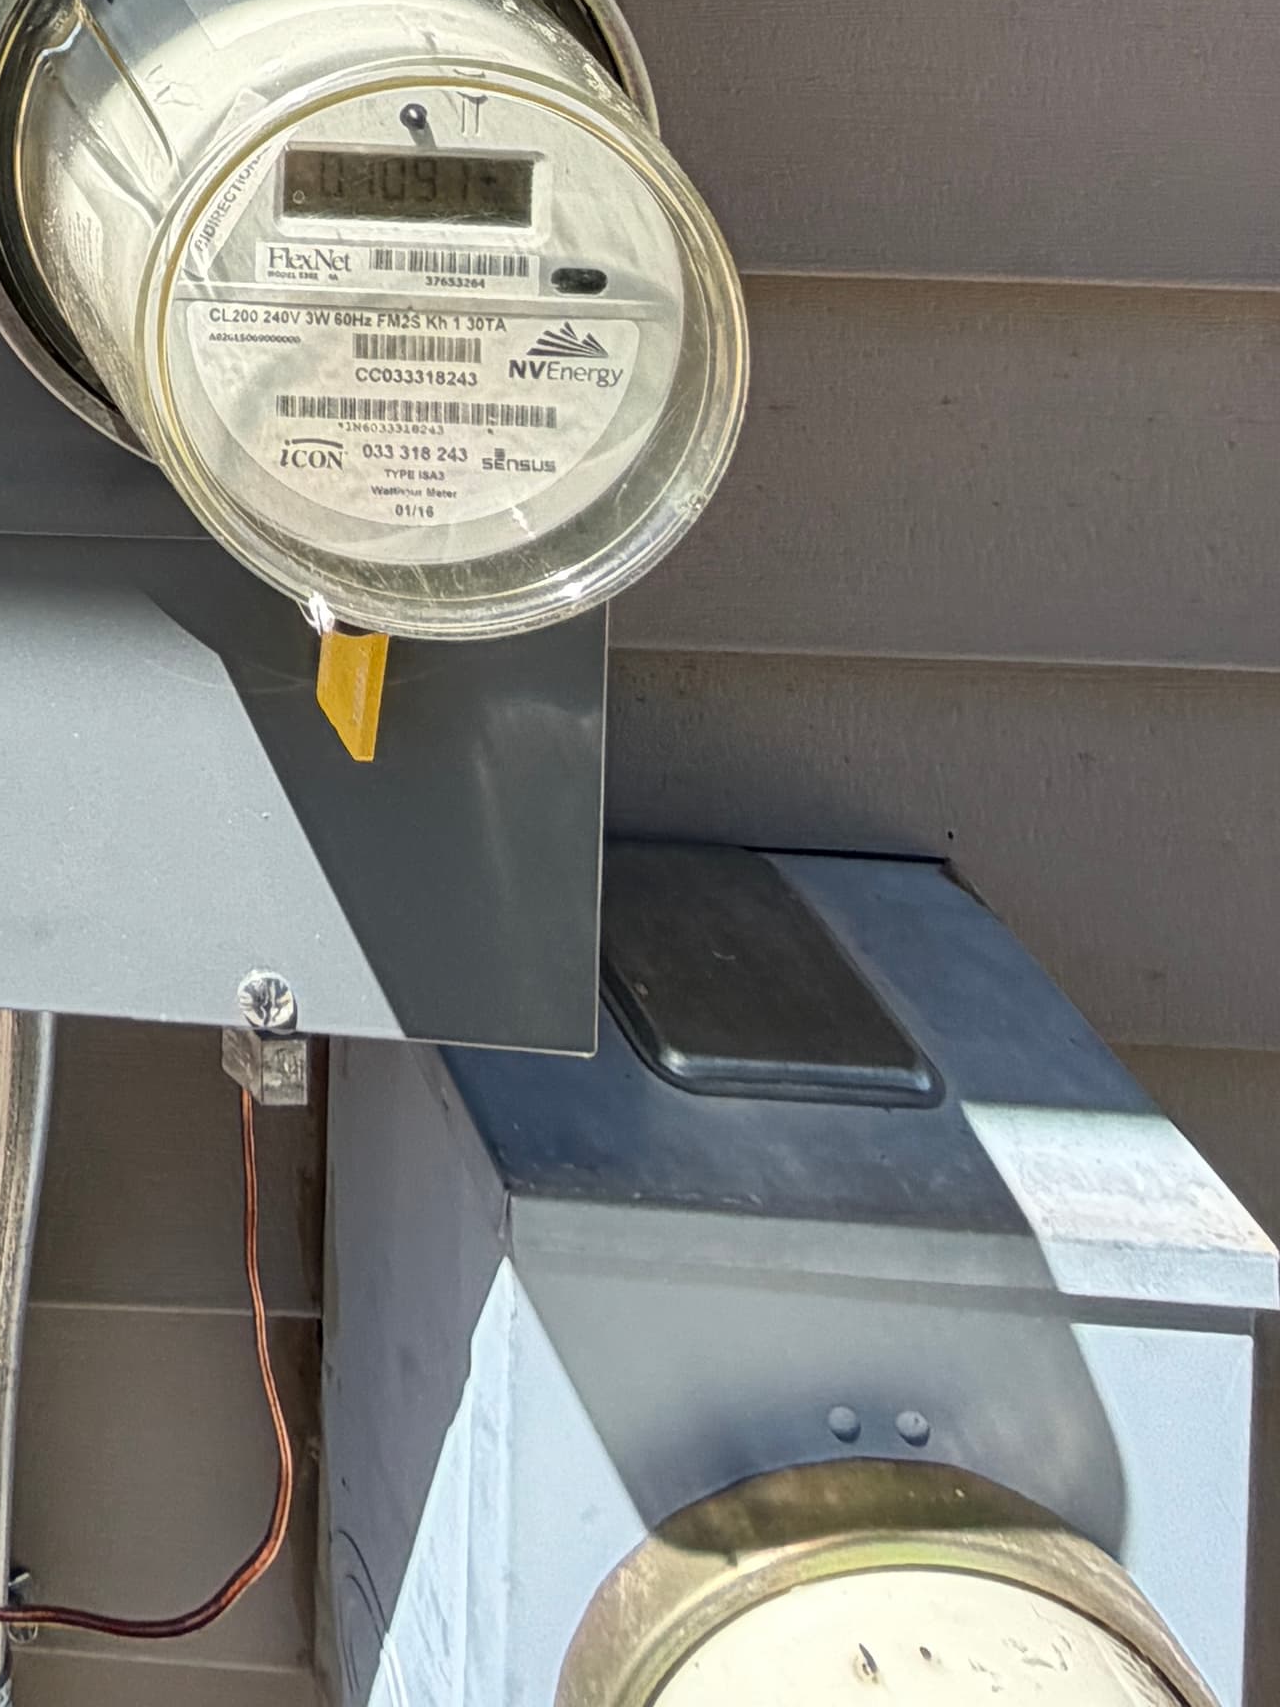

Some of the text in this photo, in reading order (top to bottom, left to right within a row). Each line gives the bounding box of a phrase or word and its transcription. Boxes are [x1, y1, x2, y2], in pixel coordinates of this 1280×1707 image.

[269, 247, 352, 272] FlexNet
[425, 276, 485, 288] 37653264
[209, 308, 258, 323] CL200
[264, 311, 301, 323] 240V
[305, 312, 330, 325] 3W
[334, 314, 372, 326] 60Hz
[377, 314, 421, 330] FM2S
[426, 316, 449, 331] Kh
[467, 317, 507, 332] 30TA
[355, 368, 478, 386] CC033318243
[362, 443, 393, 459] 033
[400, 445, 431, 460] 318
[437, 447, 468, 462] 243
[384, 469, 414, 479] TYPE
[427, 487, 456, 498] Meter
[395, 504, 434, 517] 01/16
